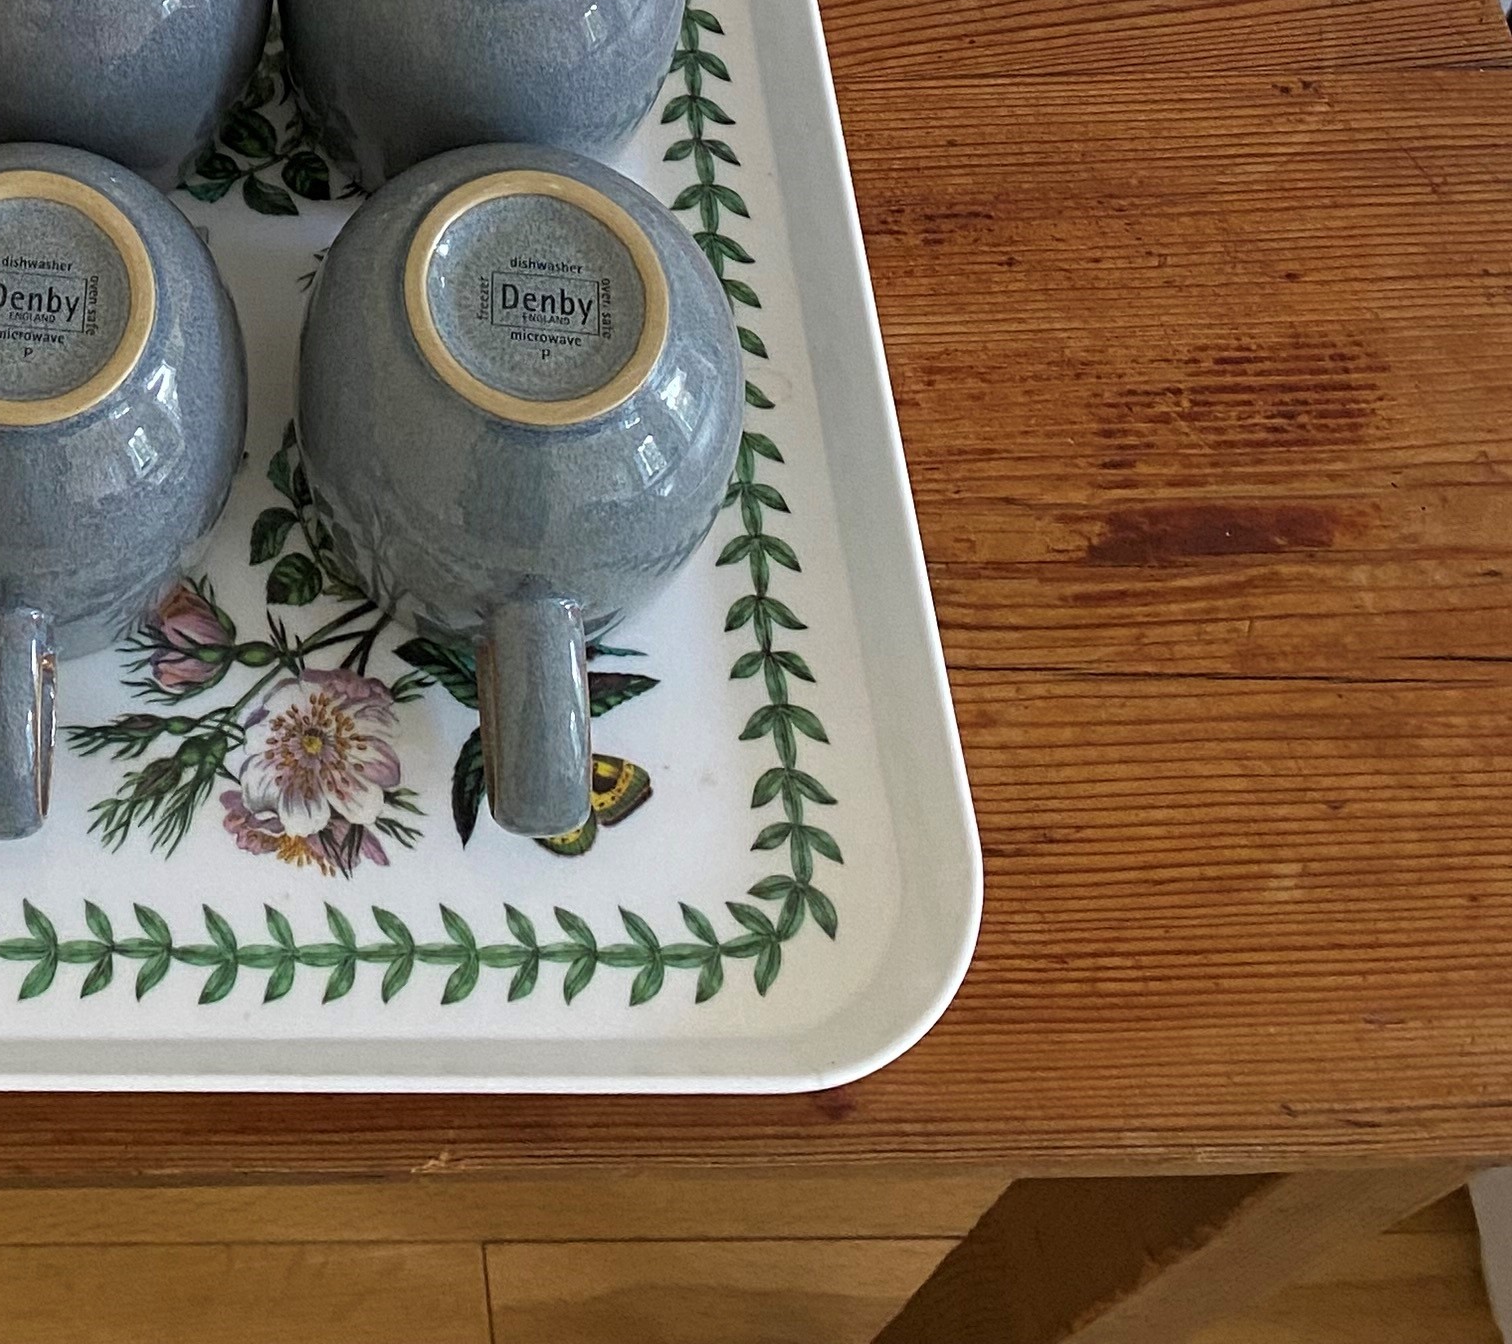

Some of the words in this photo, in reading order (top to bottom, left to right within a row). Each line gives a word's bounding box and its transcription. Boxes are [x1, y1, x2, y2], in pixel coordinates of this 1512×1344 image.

[1, 255, 73, 272] dishwasher
[509, 256, 583, 274] dishwasher
[88, 274, 99, 305] oven
[501, 283, 593, 326] Denby
[8, 312, 56, 323] ENGLAND
[85, 308, 99, 336] safe
[510, 329, 582, 347] microwave
